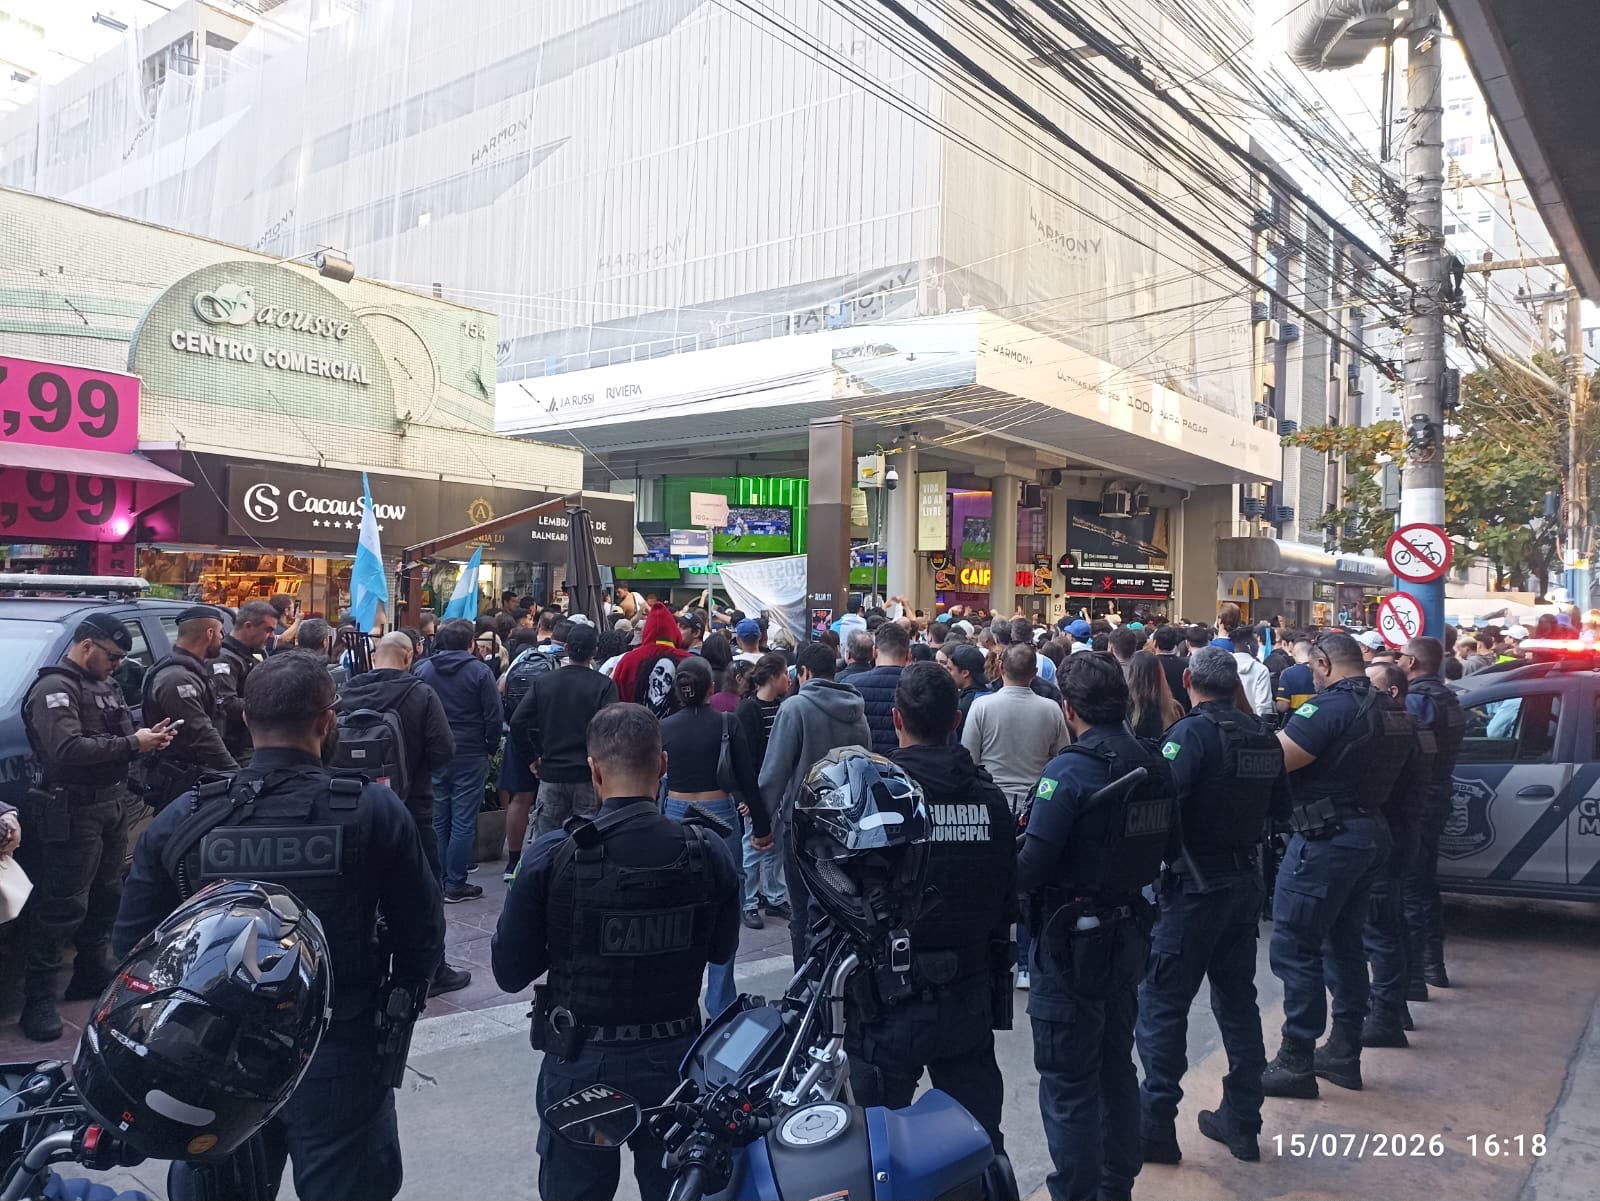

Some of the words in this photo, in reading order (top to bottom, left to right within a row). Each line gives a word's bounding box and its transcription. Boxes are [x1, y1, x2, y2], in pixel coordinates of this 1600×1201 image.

[462, 319, 487, 341] 154
[171, 330, 257, 363] CENTRO
[263, 348, 371, 384] COMERCIAL
[0, 366, 120, 438] ,99
[606, 384, 643, 399] RIVIERA
[0, 468, 118, 526] ,99
[922, 506, 941, 517] LIVRE
[538, 515, 595, 533] LEMBRS
[595, 521, 607, 531] DE
[531, 530, 569, 542] BALNEÁRI
[815, 593, 826, 601] RUA
[1128, 802, 1172, 833] CANIL
[1579, 799, 1600, 816] G
[207, 834, 334, 868] GMBC
[604, 912, 690, 951] CANIL
